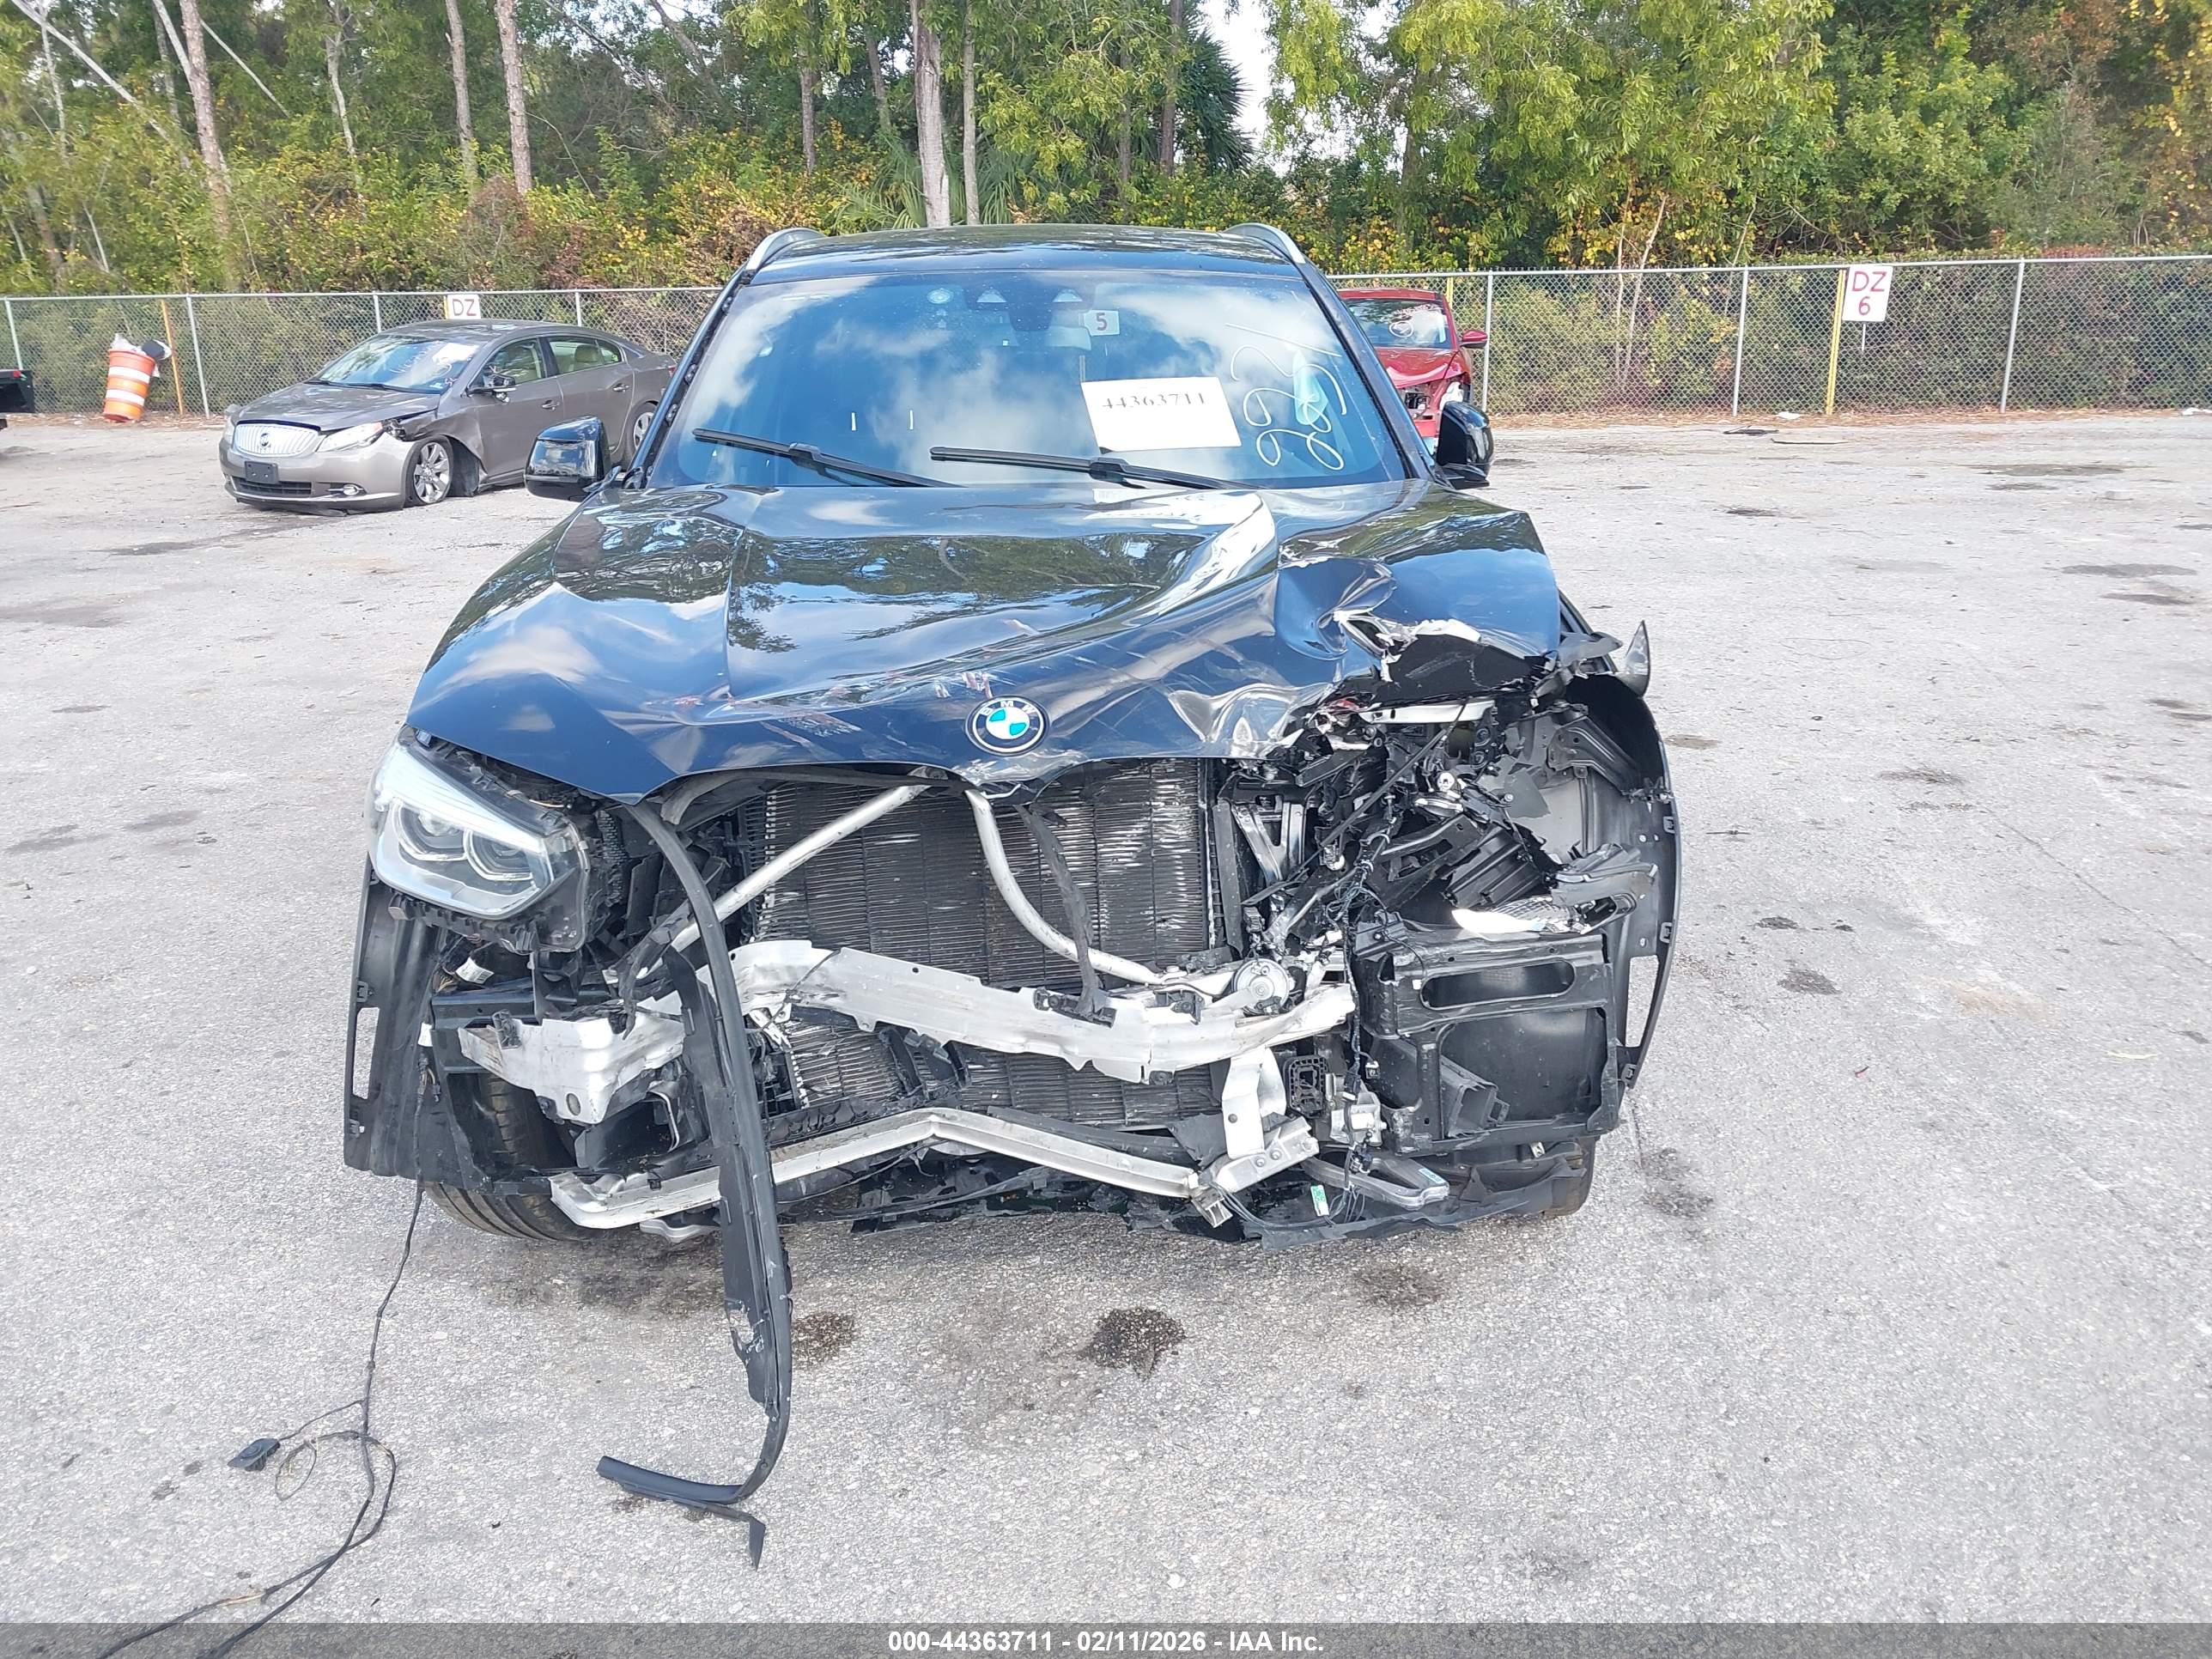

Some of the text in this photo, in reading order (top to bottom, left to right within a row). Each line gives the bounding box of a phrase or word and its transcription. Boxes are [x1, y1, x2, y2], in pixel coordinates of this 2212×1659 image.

[1852, 270, 1887, 291] DZ
[452, 298, 477, 316] DZ
[1858, 295, 1871, 315] 6
[1096, 312, 1108, 331] 5
[979, 700, 1038, 716] BMW
